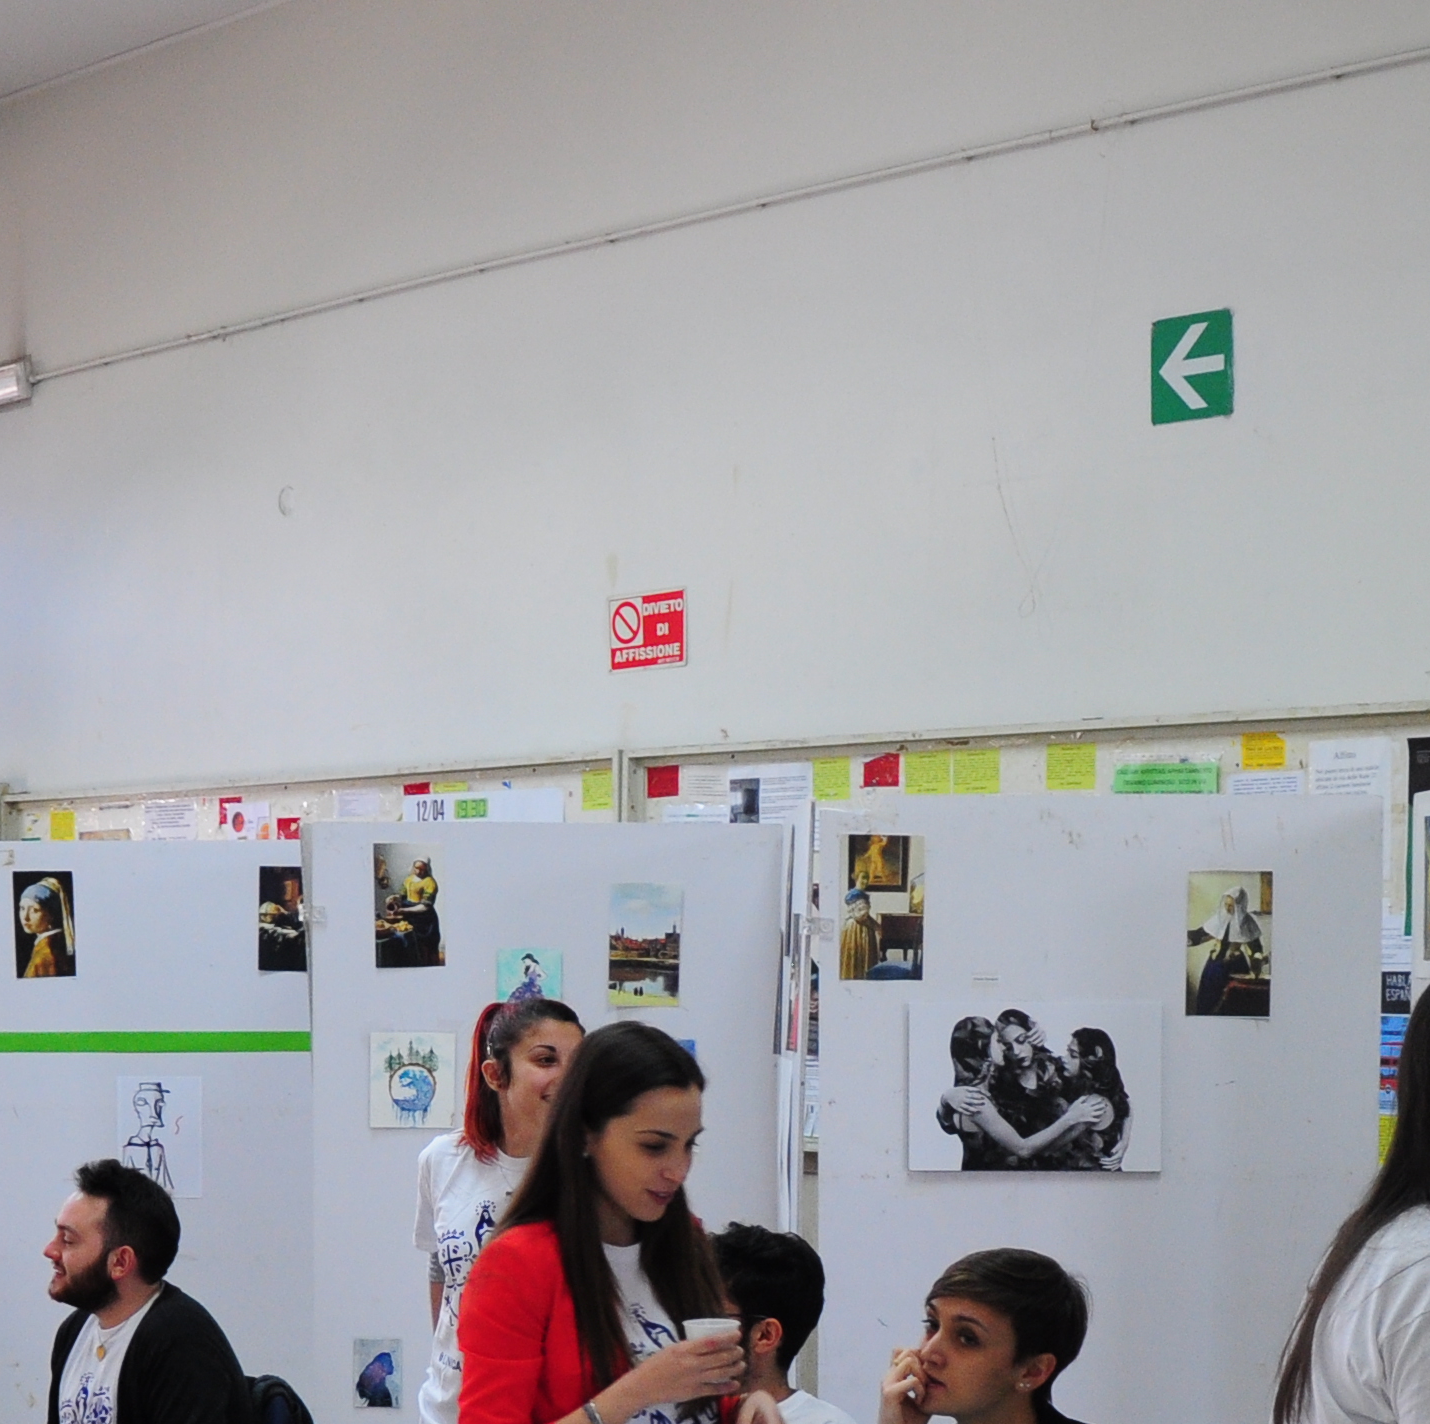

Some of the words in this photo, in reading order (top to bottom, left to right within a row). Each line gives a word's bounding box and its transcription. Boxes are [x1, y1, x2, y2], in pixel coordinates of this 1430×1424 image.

[643, 599, 683, 616] DIVIETO
[657, 623, 669, 636] DI
[614, 643, 681, 663] AFFISSIONE
[416, 799, 444, 821] 12/04
